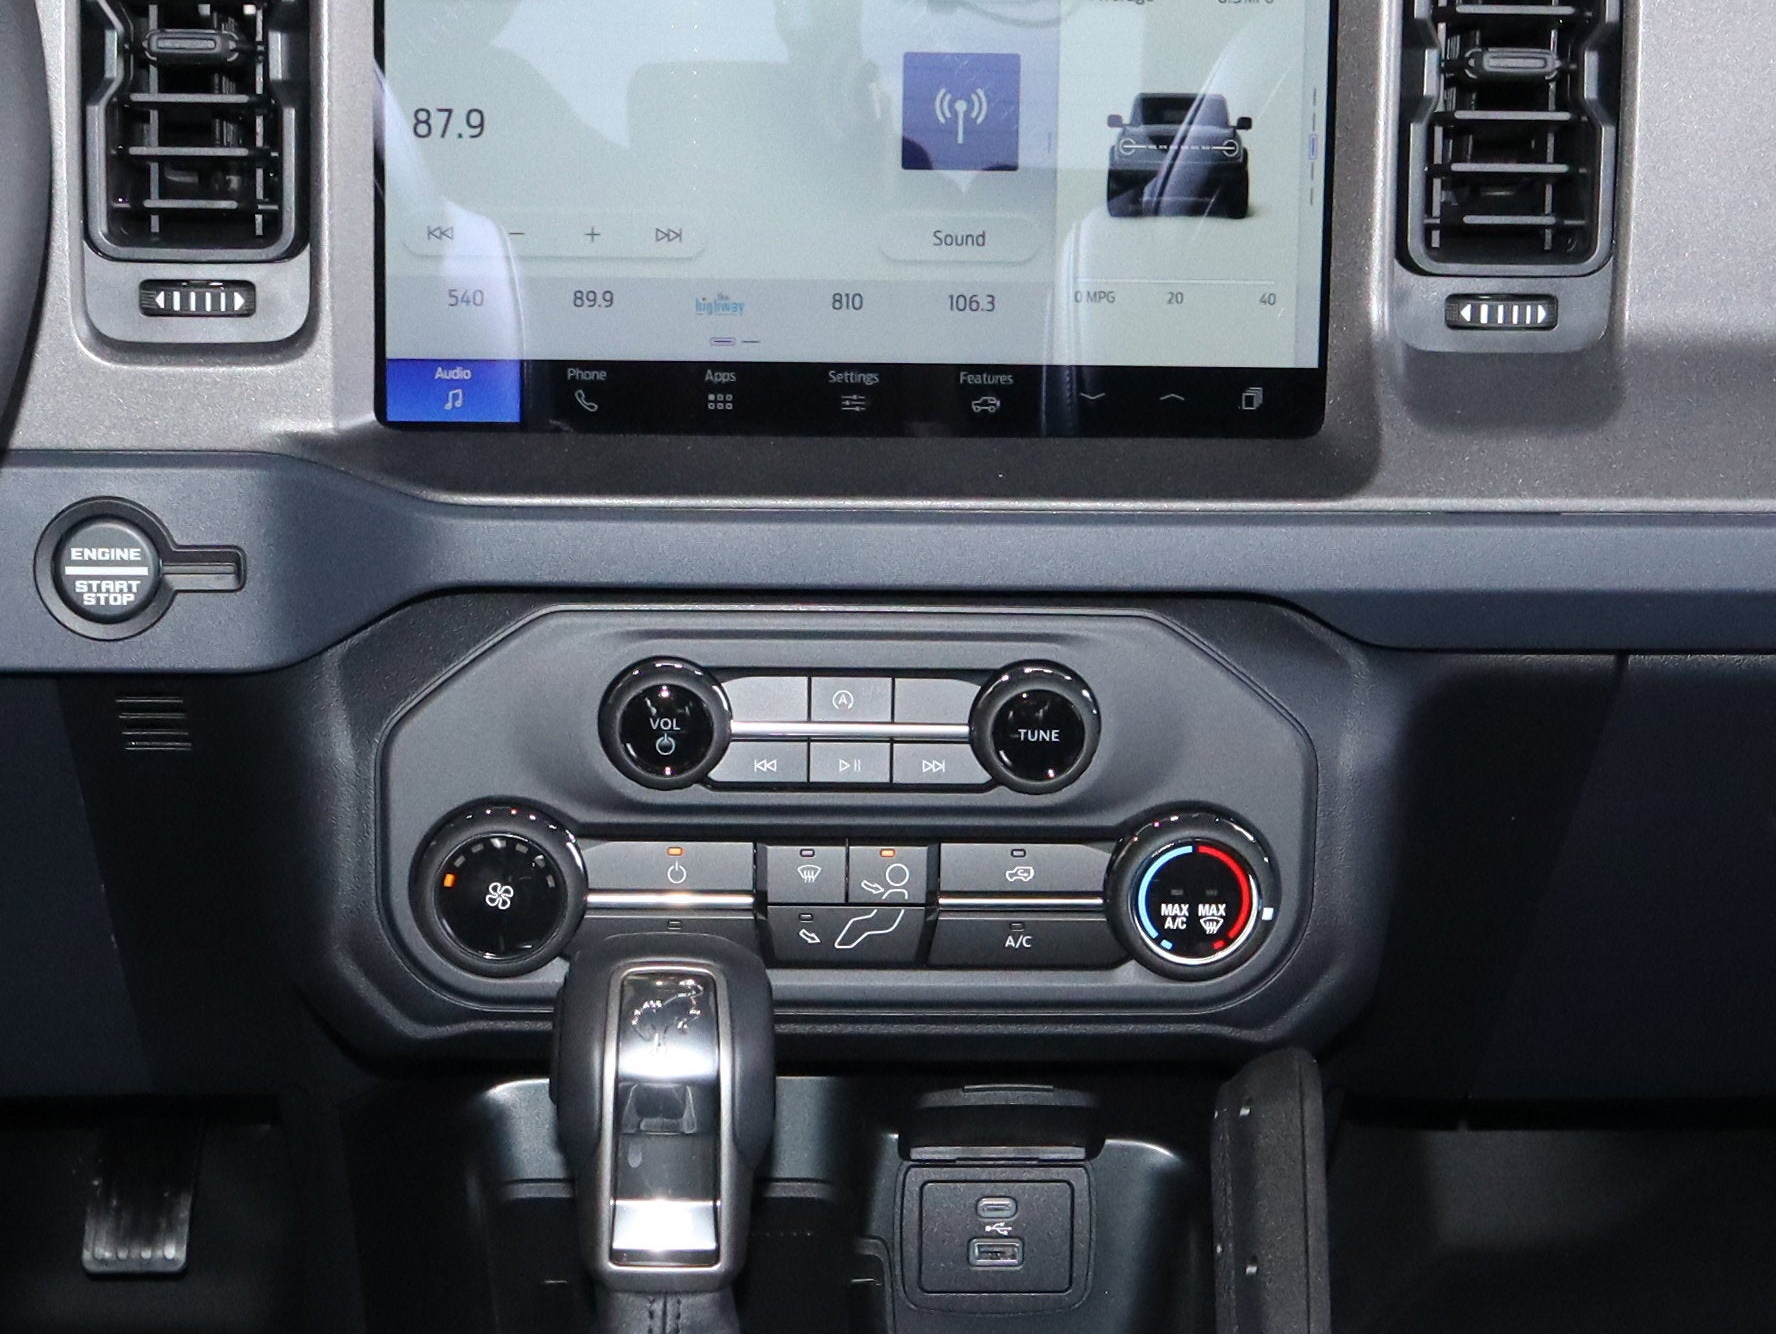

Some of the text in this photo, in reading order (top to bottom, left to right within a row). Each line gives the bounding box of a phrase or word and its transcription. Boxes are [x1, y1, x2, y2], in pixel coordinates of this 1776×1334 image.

[413, 108, 485, 140] 87.9
[933, 230, 985, 249] Sound
[447, 289, 484, 308] 540
[572, 290, 614, 309] 89.9
[831, 293, 863, 311] 810
[947, 293, 995, 312] 106.3
[1087, 291, 1115, 303] MPG
[1168, 292, 1184, 304] 20
[1260, 293, 1276, 305] 40
[435, 367, 471, 380] Audio
[567, 367, 607, 381] Phone
[704, 368, 736, 385] Apps
[829, 370, 879, 386] Settings
[959, 371, 1013, 385] Features
[70, 547, 142, 561] ENGINE
[75, 580, 140, 593] START
[83, 593, 134, 605] STOP
[649, 718, 681, 731] VOL
[1018, 729, 1060, 742] TUNE
[1161, 904, 1189, 916] MAX
[1198, 904, 1226, 916] MAX
[1164, 917, 1187, 929] A/C
[1004, 933, 1033, 950] A/C
